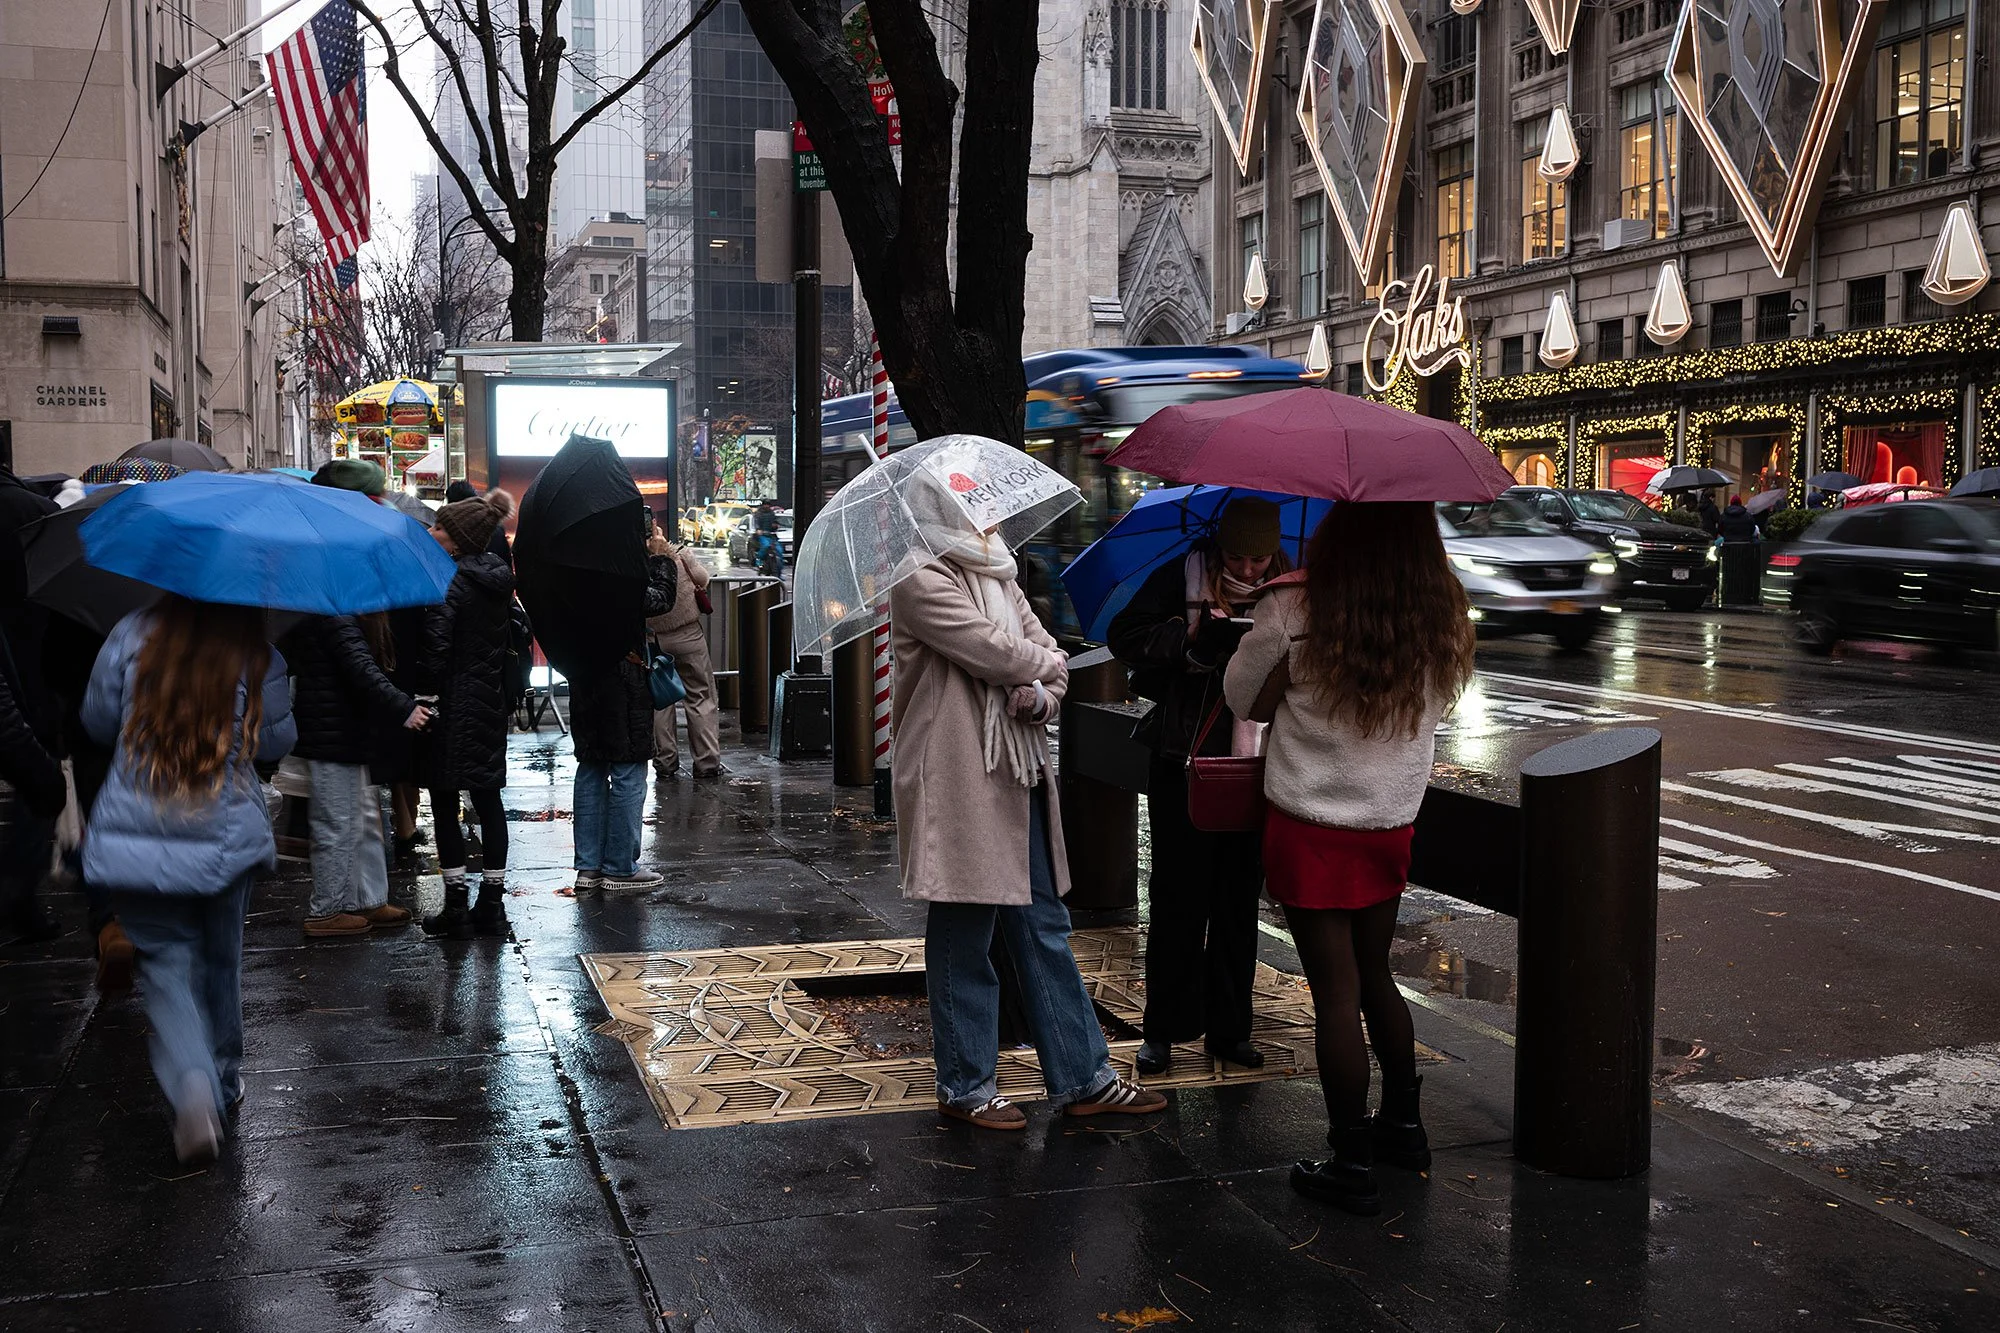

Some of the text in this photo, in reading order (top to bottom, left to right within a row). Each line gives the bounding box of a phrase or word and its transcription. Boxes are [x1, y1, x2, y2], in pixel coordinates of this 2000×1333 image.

[873, 83, 895, 97] Holi
[800, 154, 811, 164] No
[800, 165, 825, 177] at this
[799, 179, 826, 189] November
[1362, 263, 1471, 392] Saks
[36, 385, 107, 395] CHANNEL
[36, 397, 107, 407] GARDENS
[528, 408, 638, 438] Cartier
[960, 461, 1048, 508] NEW YORK
